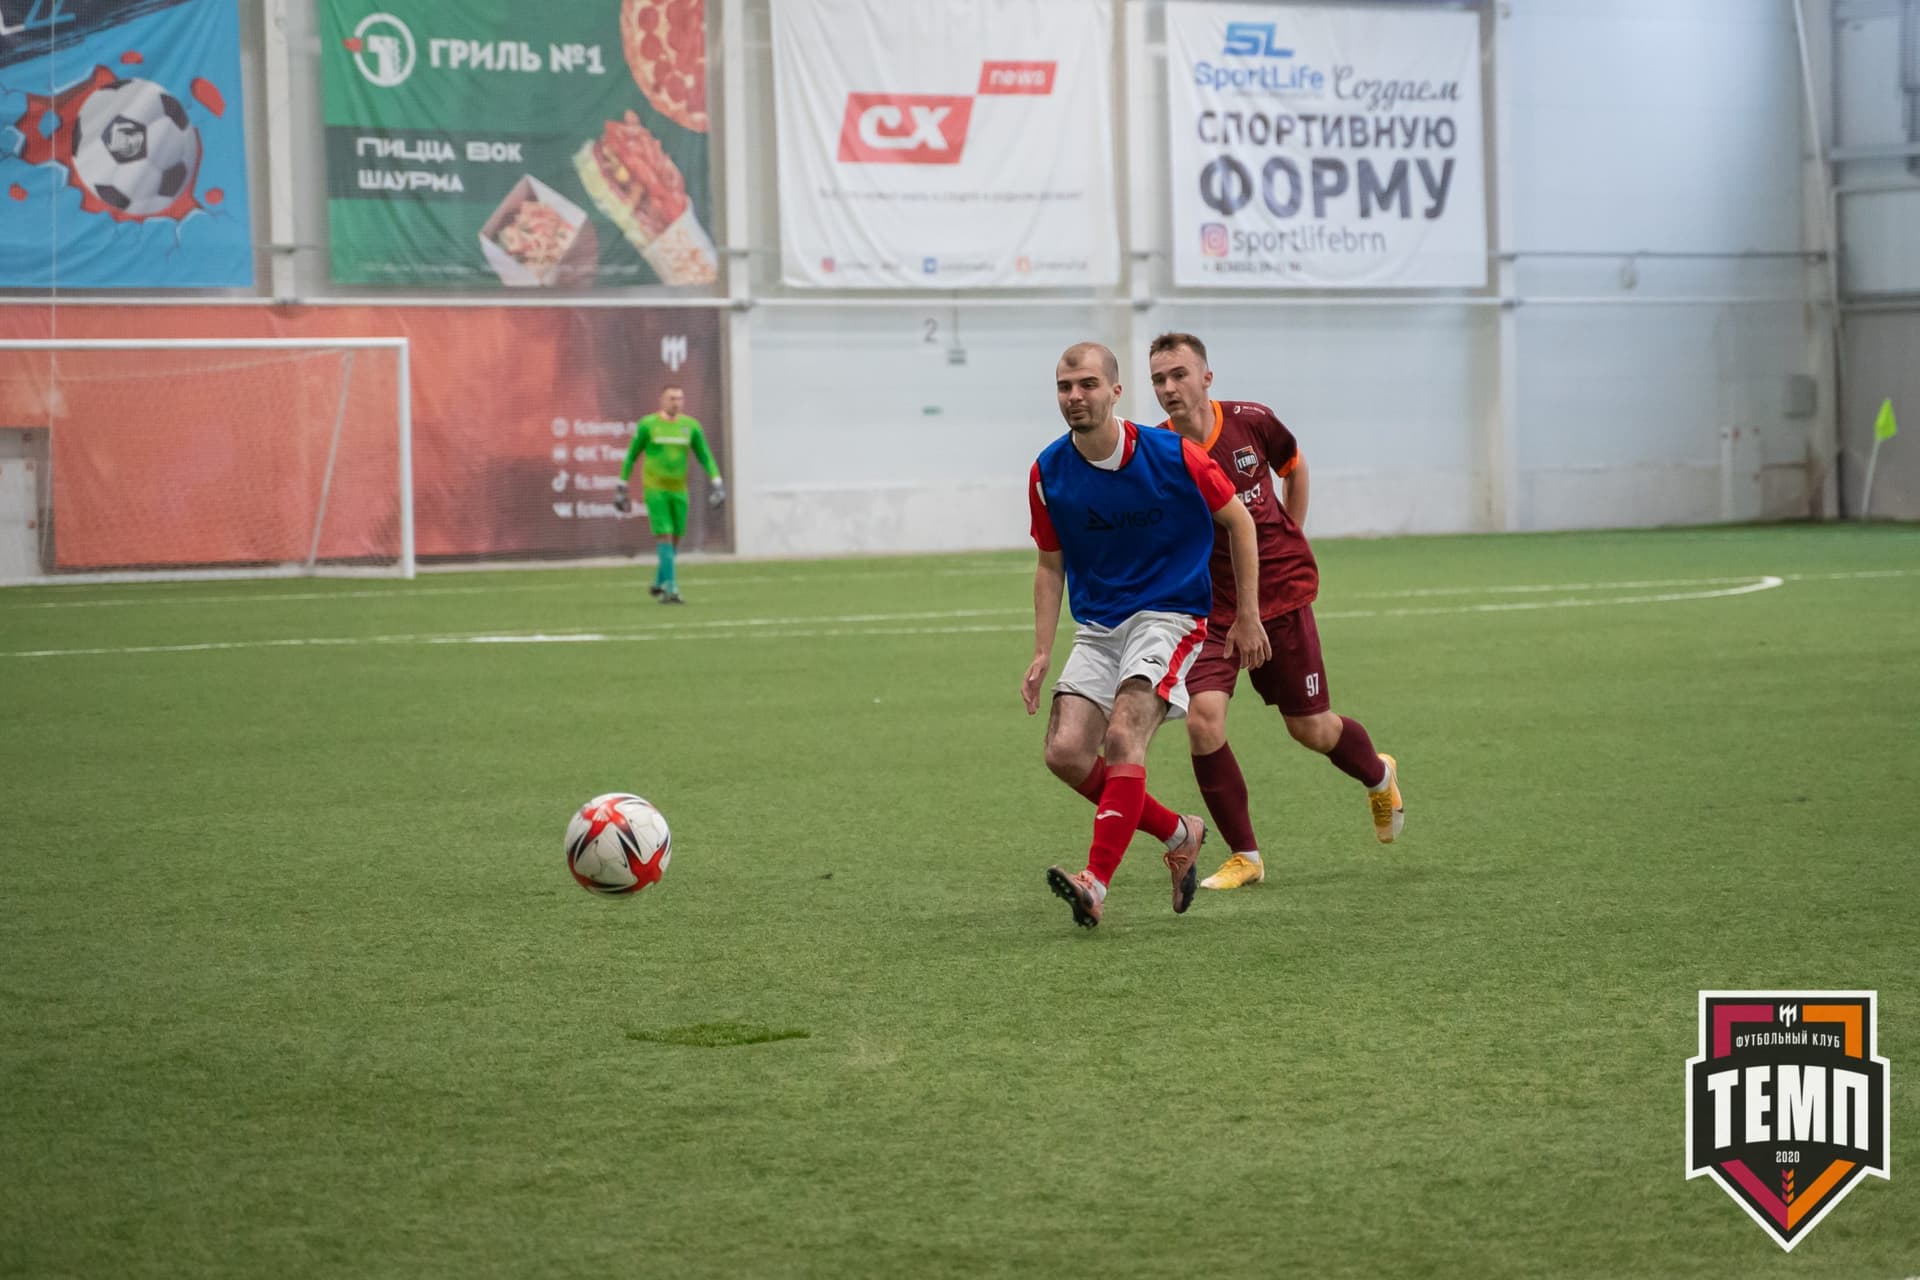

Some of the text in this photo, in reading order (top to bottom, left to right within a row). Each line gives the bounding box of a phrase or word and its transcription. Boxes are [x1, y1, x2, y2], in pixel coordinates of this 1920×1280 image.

[428, 38, 606, 75] ГРИЛЬ №1
[989, 69, 1046, 87] news
[1194, 61, 1325, 91] SportLife
[1333, 64, 1461, 111] Создаем
[1197, 110, 1457, 149] СПОРТИВНУЮ
[356, 136, 523, 162] ПИЦЦА ВОК
[357, 169, 465, 193] ШАУРМА
[1199, 154, 1456, 220] ФОРМУ
[1232, 224, 1387, 257] sportlifebrn
[923, 317, 939, 343] 2
[1305, 672, 1320, 697] 97
